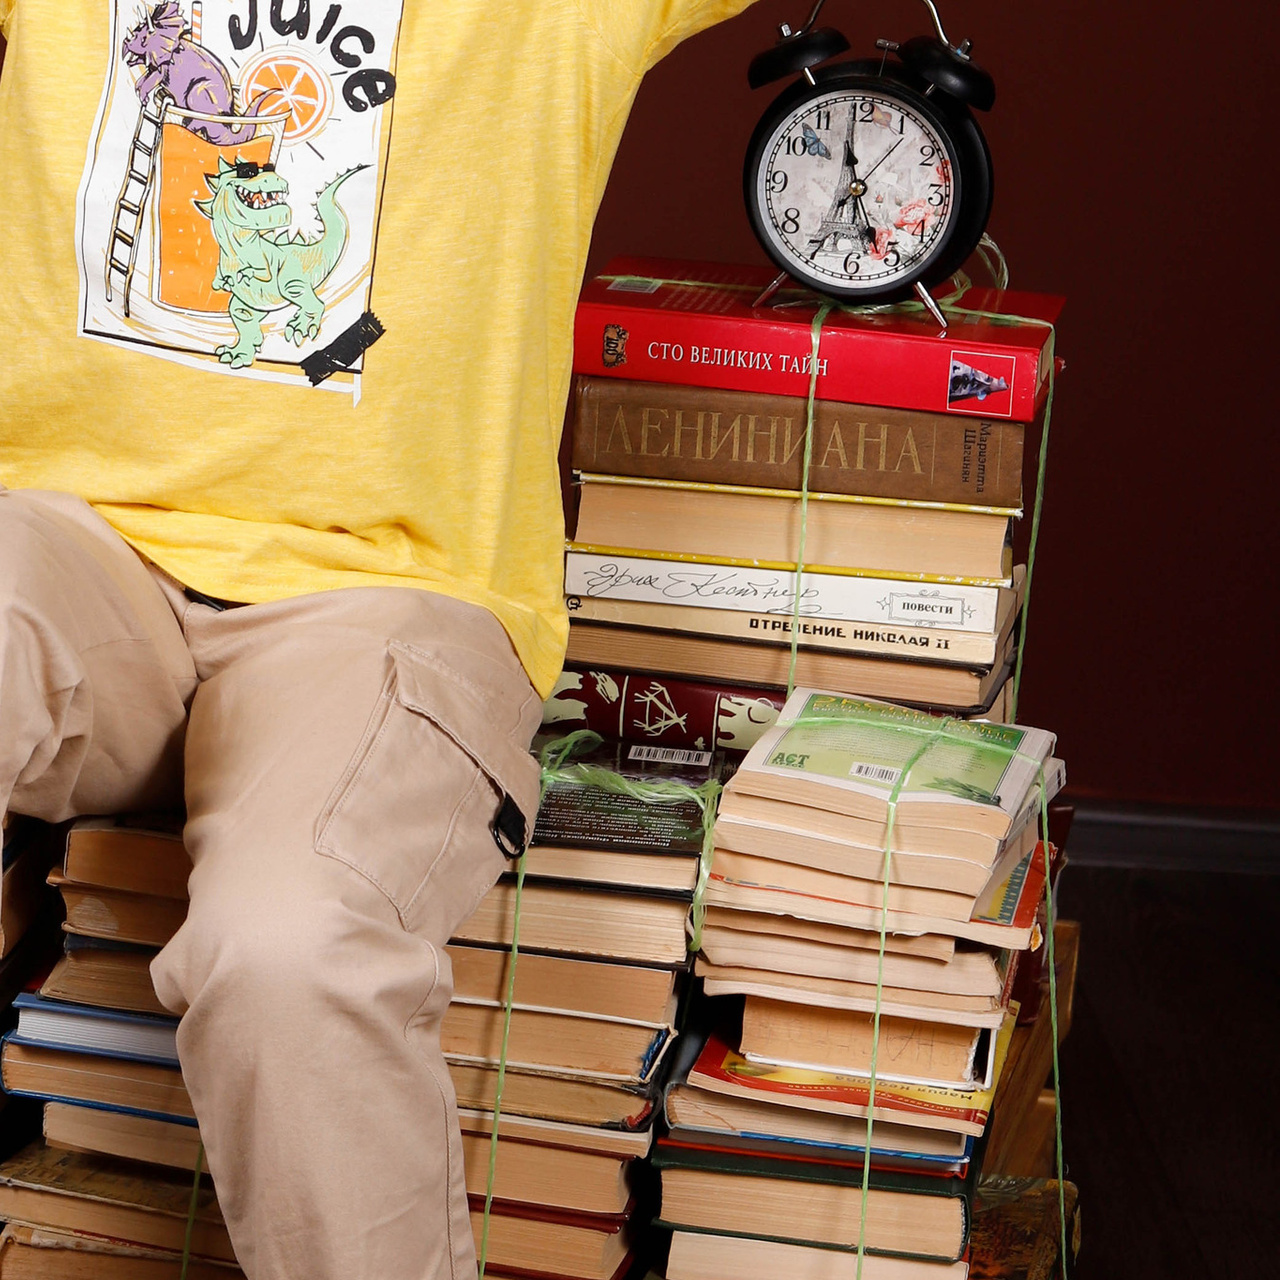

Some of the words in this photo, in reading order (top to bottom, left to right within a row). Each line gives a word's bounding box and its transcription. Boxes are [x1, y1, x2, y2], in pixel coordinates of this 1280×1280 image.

[816, 110, 831, 131] 11
[851, 102, 875, 123] 12
[898, 115, 905, 135] 1
[785, 136, 807, 157] 10
[919, 145, 936, 167] 2
[771, 170, 788, 193] 9
[927, 183, 943, 206] 3
[781, 207, 800, 234] 8
[912, 219, 930, 243] 4
[807, 239, 824, 260] 7
[883, 241, 901, 267] 5
[843, 252, 861, 275] 6
[647, 341, 684, 362] СТО
[690, 346, 773, 371] ВЕЛИКИХ
[601, 404, 925, 475] ЛЕНИНИАНА
[962, 428, 977, 483] Шагинян
[976, 422, 992, 493] Мариэтта
[853, 629, 930, 647] НИКОЛАЯ
[772, 752, 810, 765] АСТ
